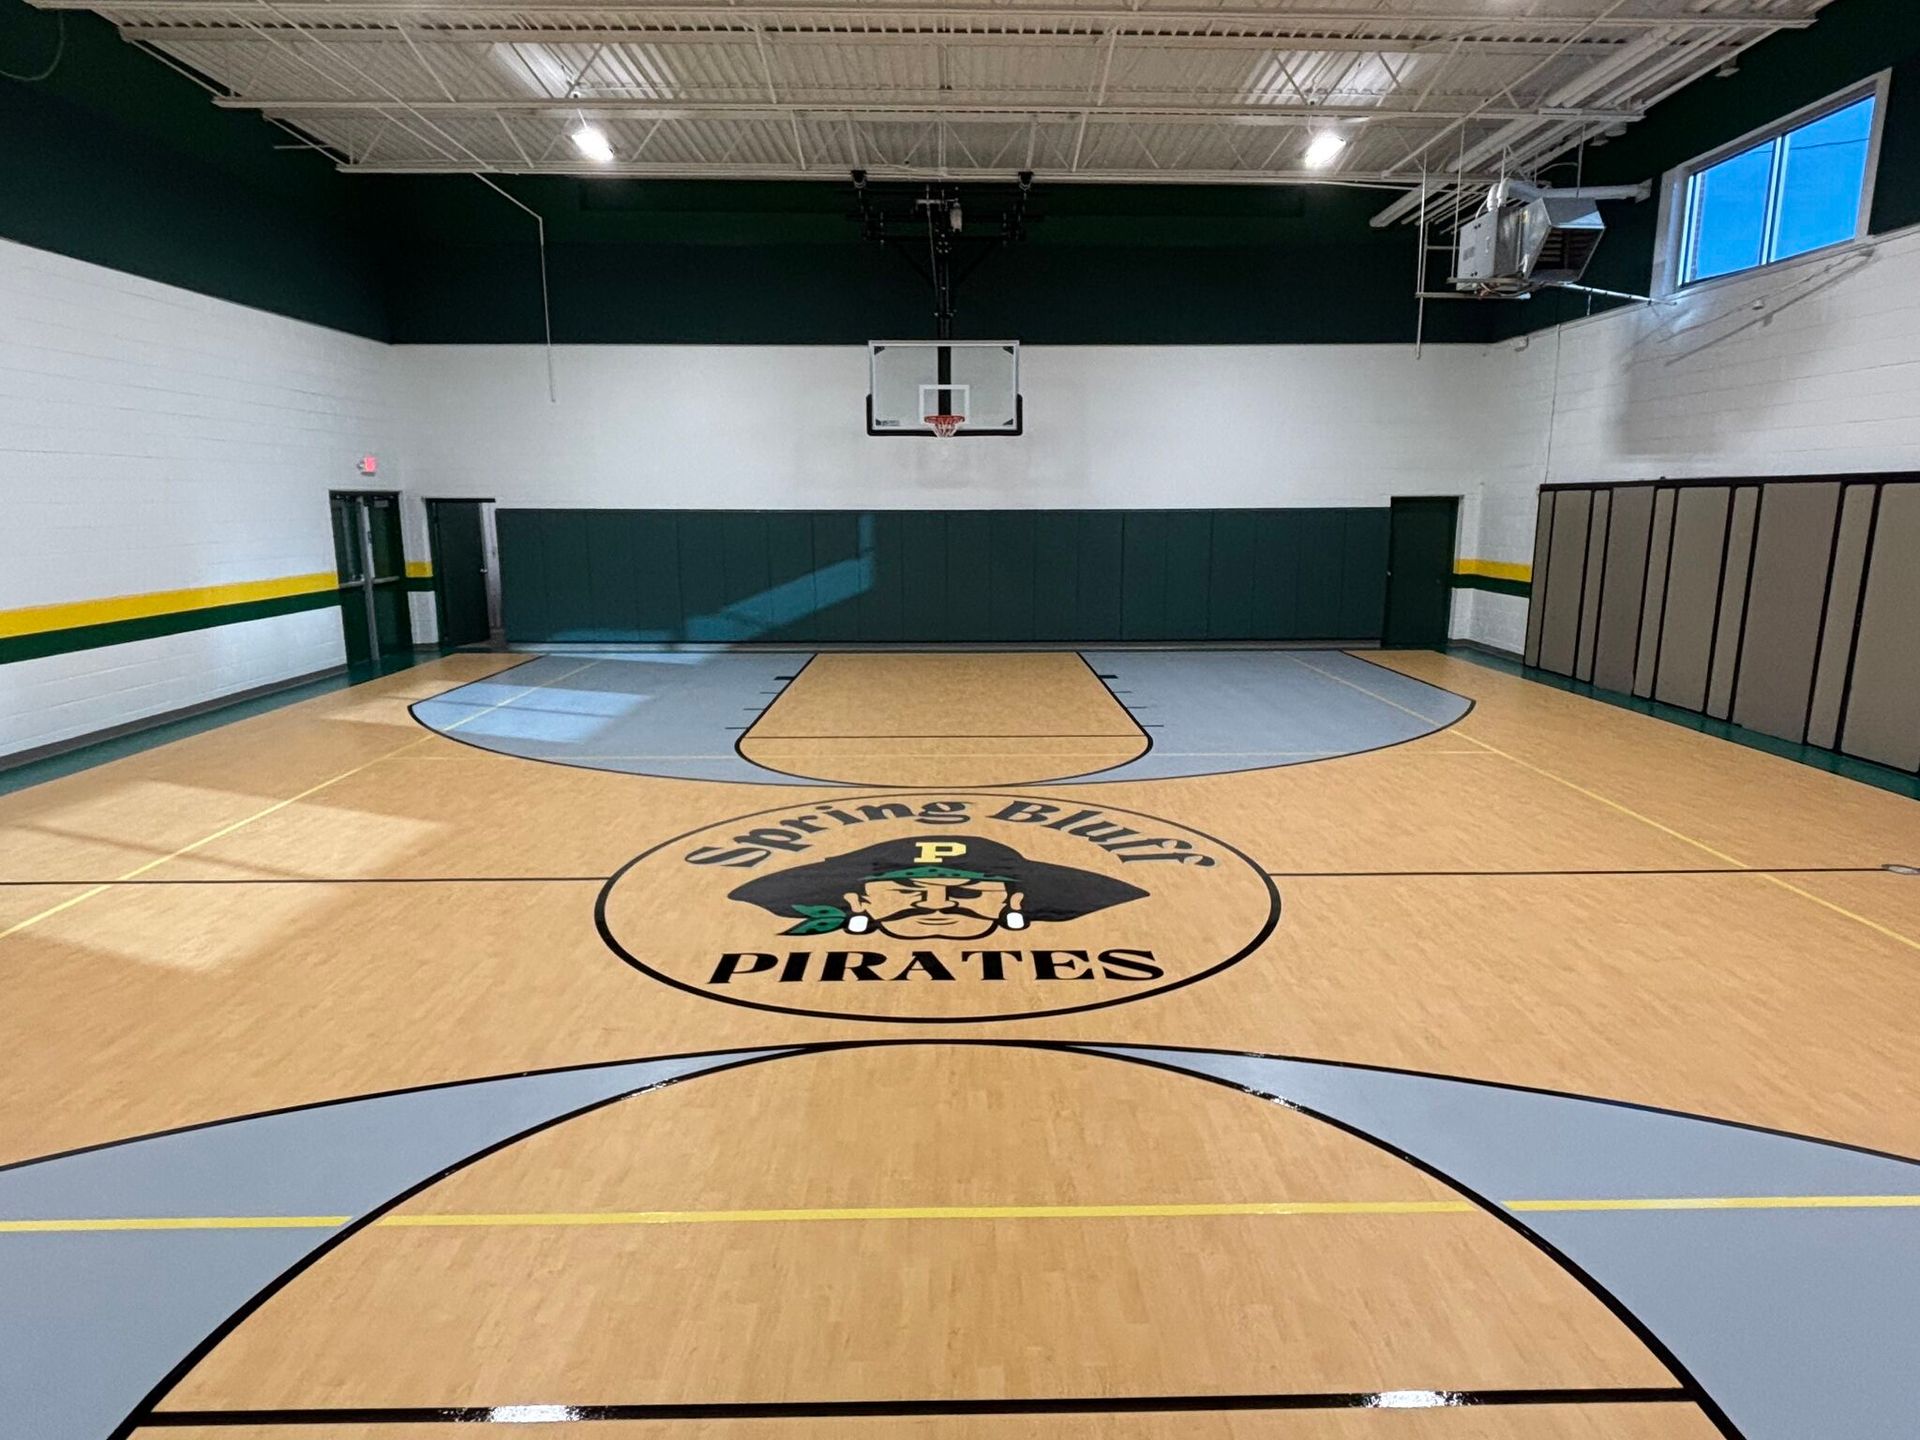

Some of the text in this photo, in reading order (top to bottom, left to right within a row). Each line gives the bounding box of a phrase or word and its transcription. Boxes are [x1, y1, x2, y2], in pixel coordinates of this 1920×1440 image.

[685, 800, 1216, 868] Spring Bluff
[914, 842, 966, 863] P
[708, 949, 1164, 984] PIRATES
